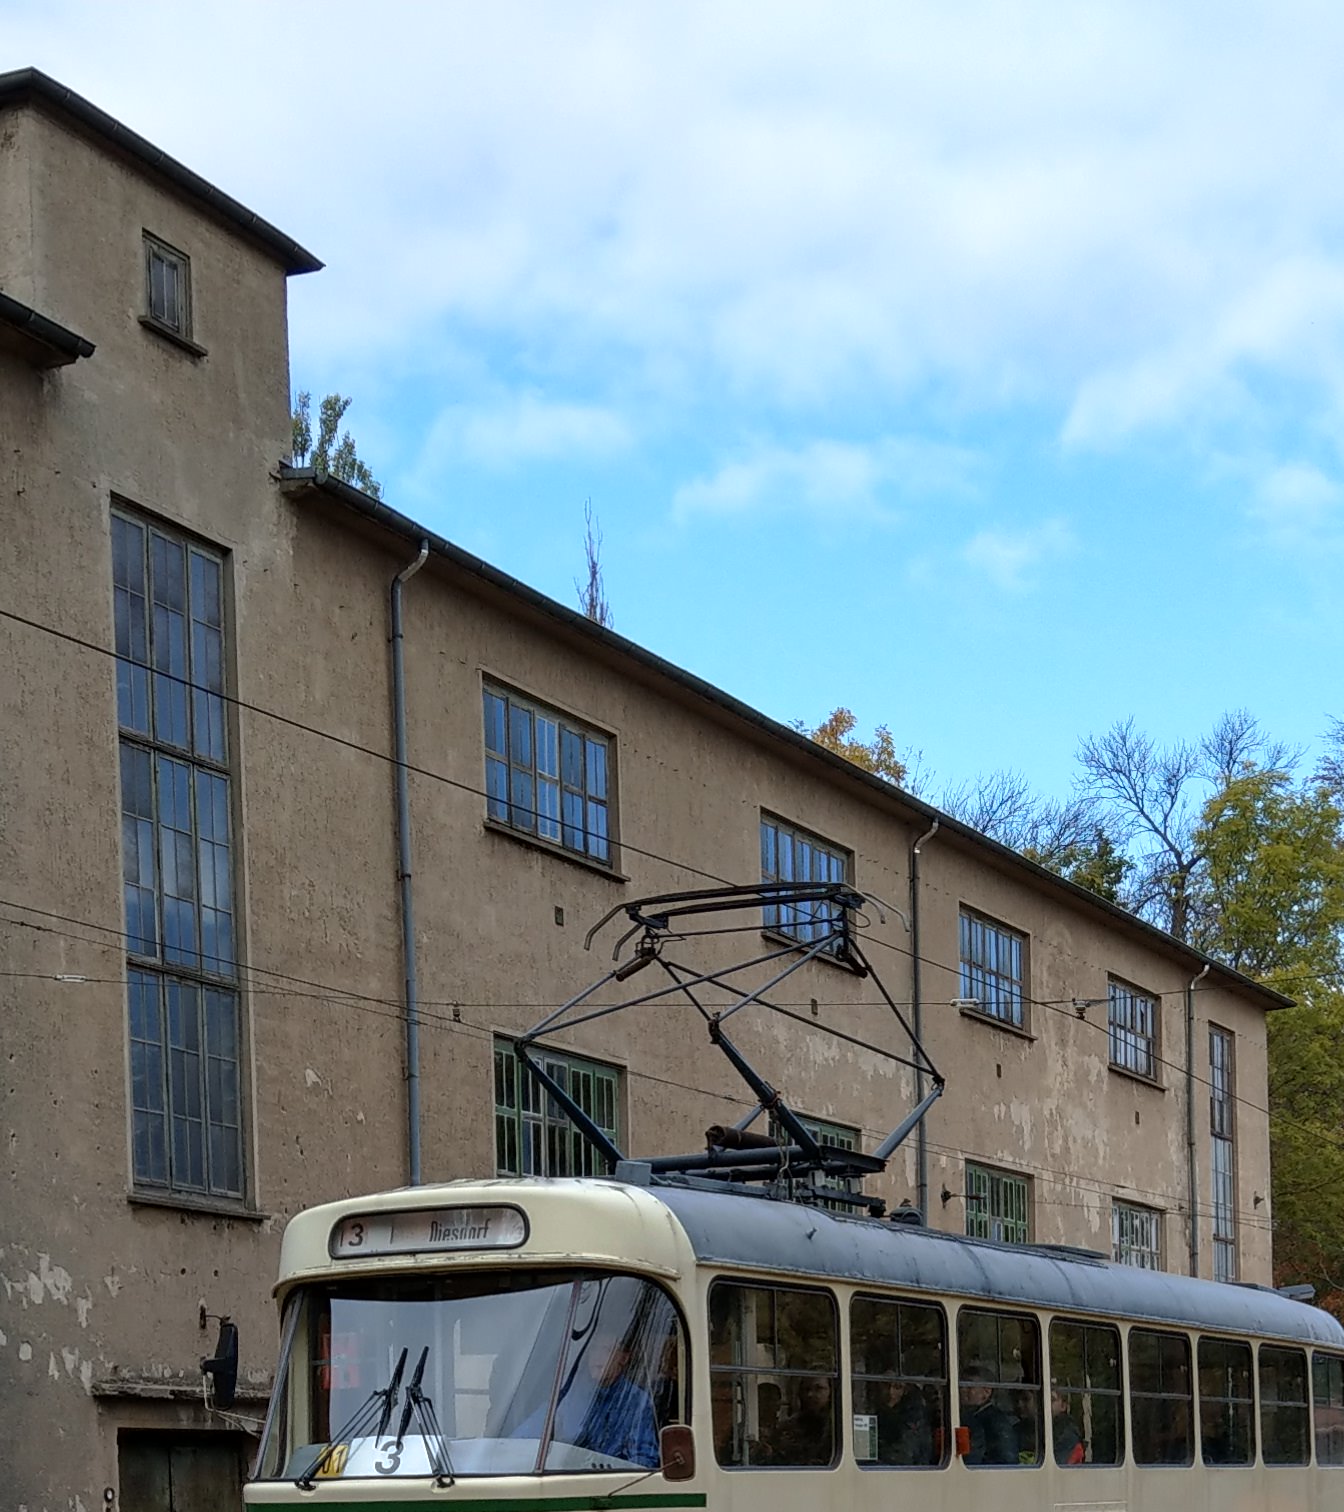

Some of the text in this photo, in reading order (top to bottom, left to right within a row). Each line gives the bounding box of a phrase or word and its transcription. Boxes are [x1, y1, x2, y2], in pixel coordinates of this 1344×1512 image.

[348, 1217, 491, 1247] 3 Diesdorf
[374, 1440, 404, 1475] 3
